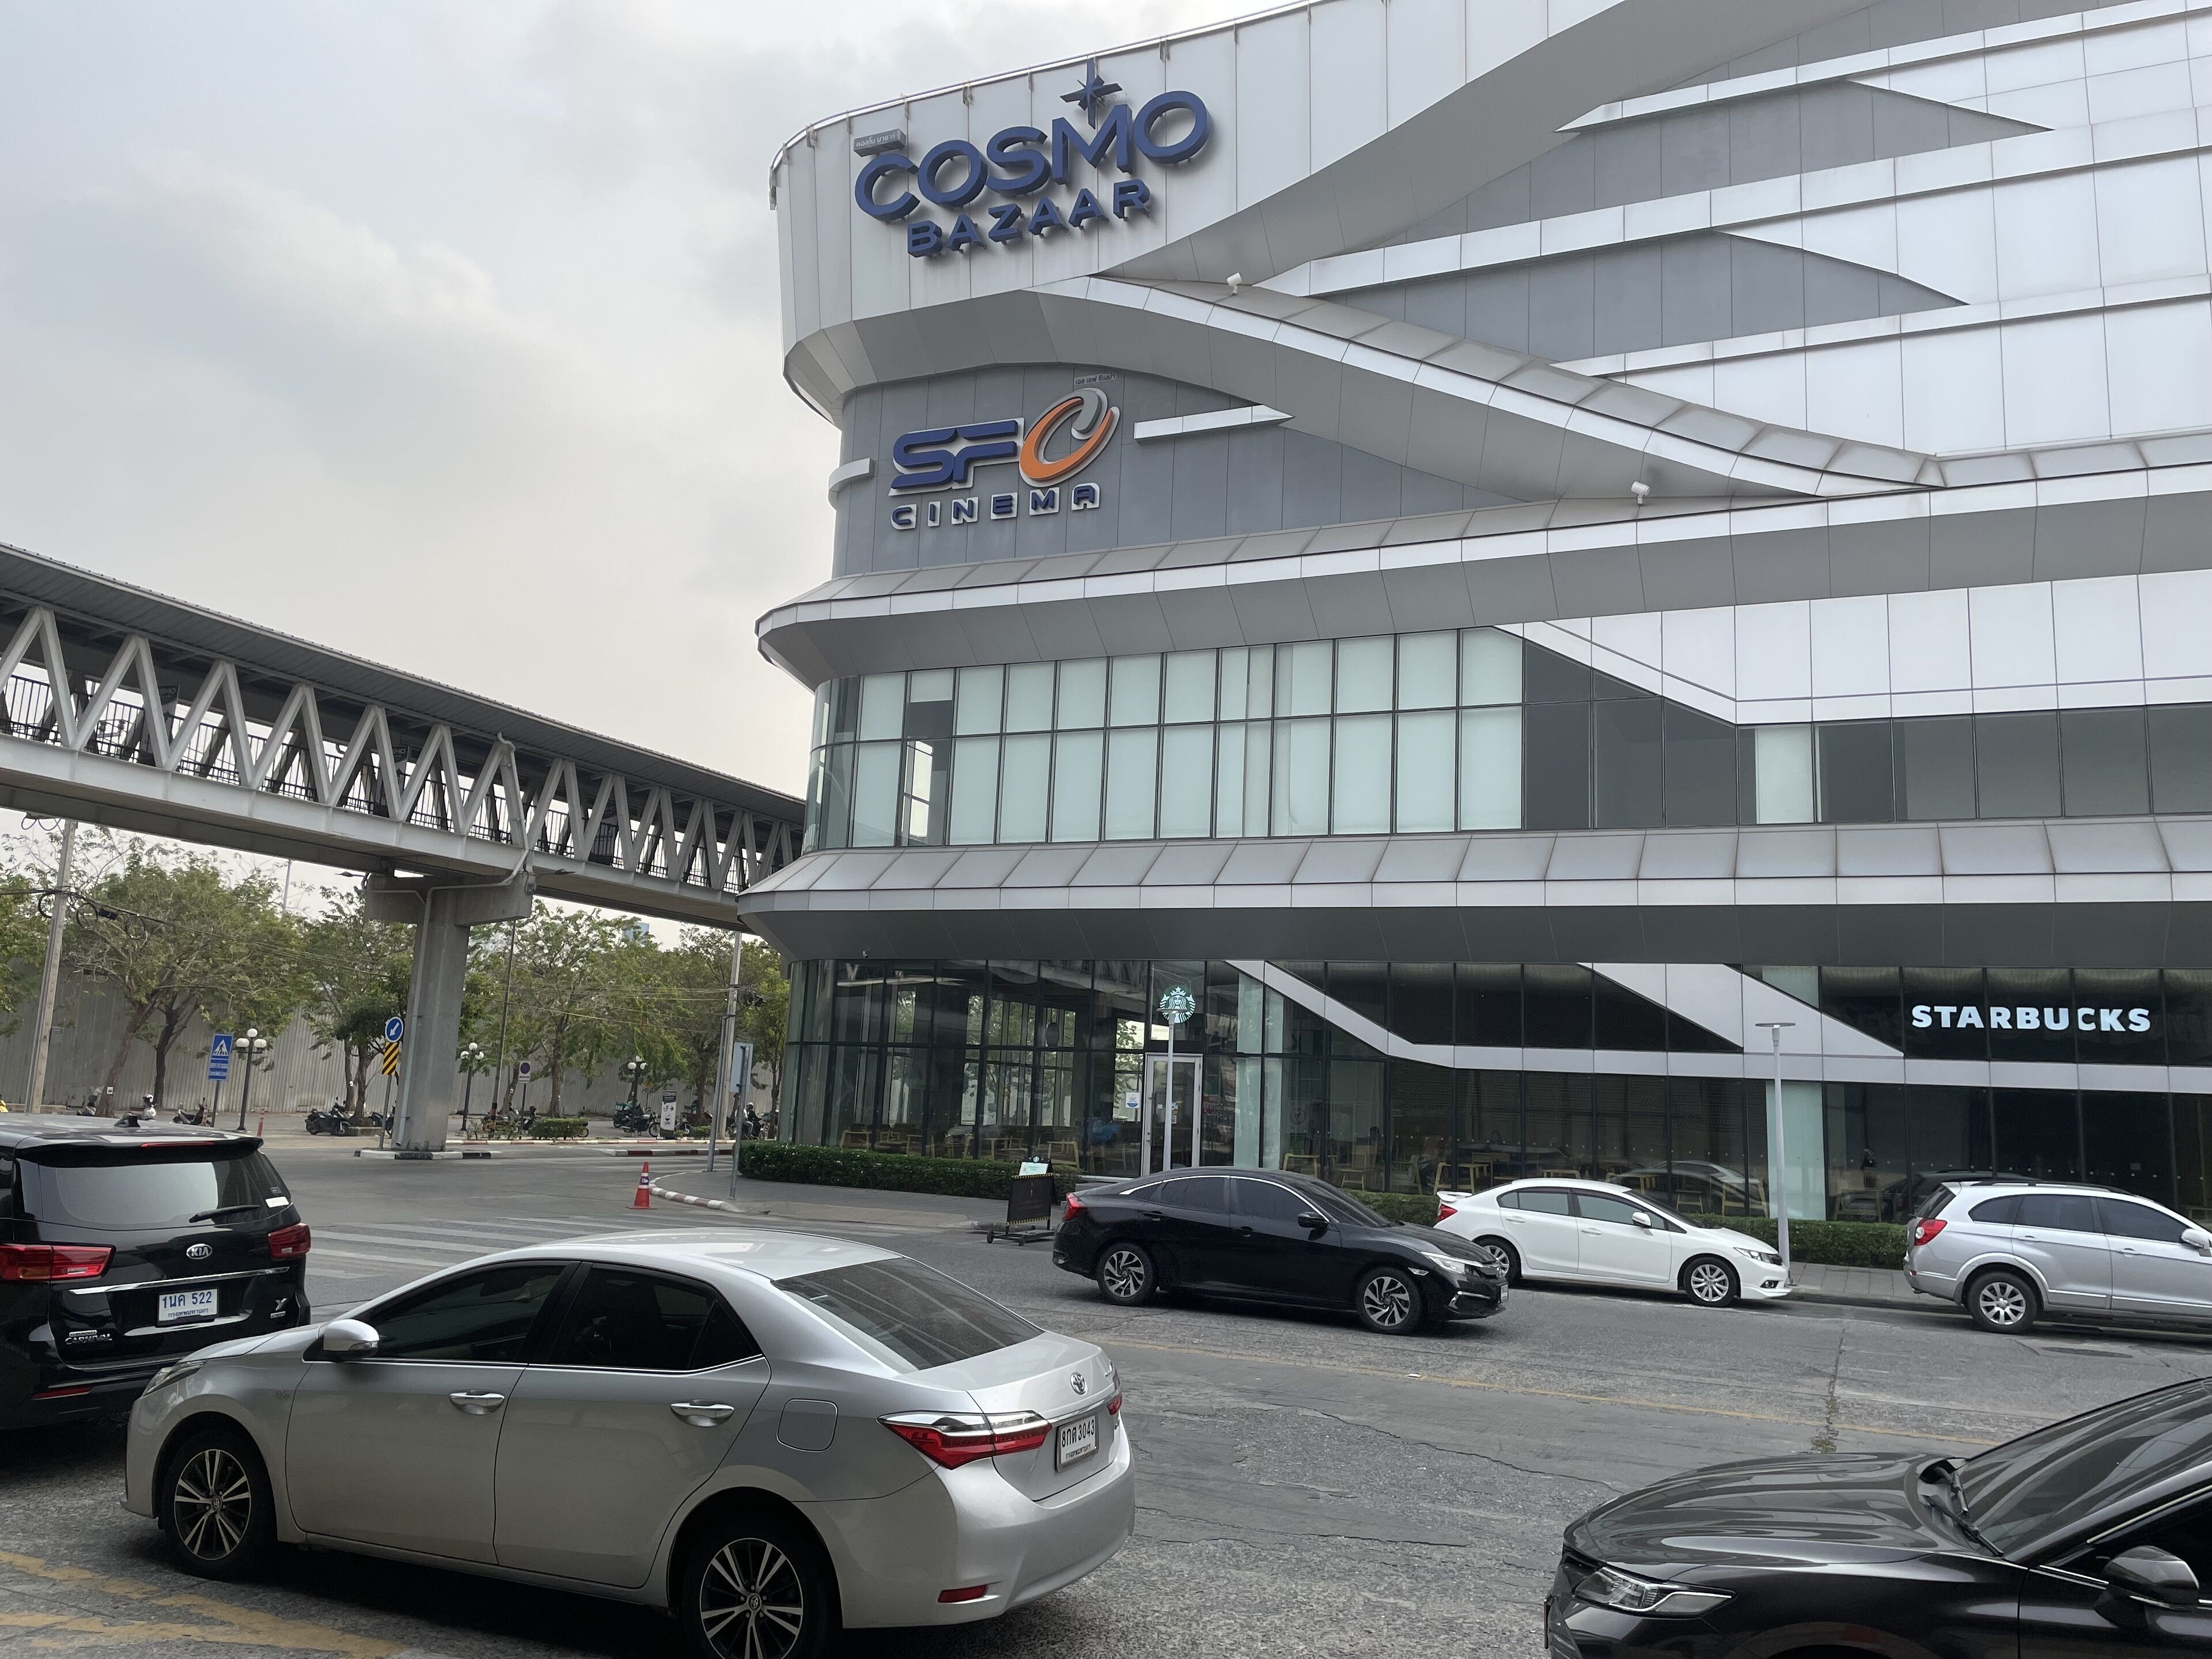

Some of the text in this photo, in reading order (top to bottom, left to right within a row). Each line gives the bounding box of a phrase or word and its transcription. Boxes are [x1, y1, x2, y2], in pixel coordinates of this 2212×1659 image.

[856, 136, 876, 147] คอสโม
[855, 90, 1210, 221] COSMO
[907, 179, 1151, 257] BAZAAR
[892, 483, 1100, 530] CINEMA
[1912, 1005, 2150, 1032] STARBUCKS
[191, 1247, 209, 1256] KIA
[162, 1291, 212, 1309] 1นค 522
[1078, 1419, 1094, 1441] 3043
